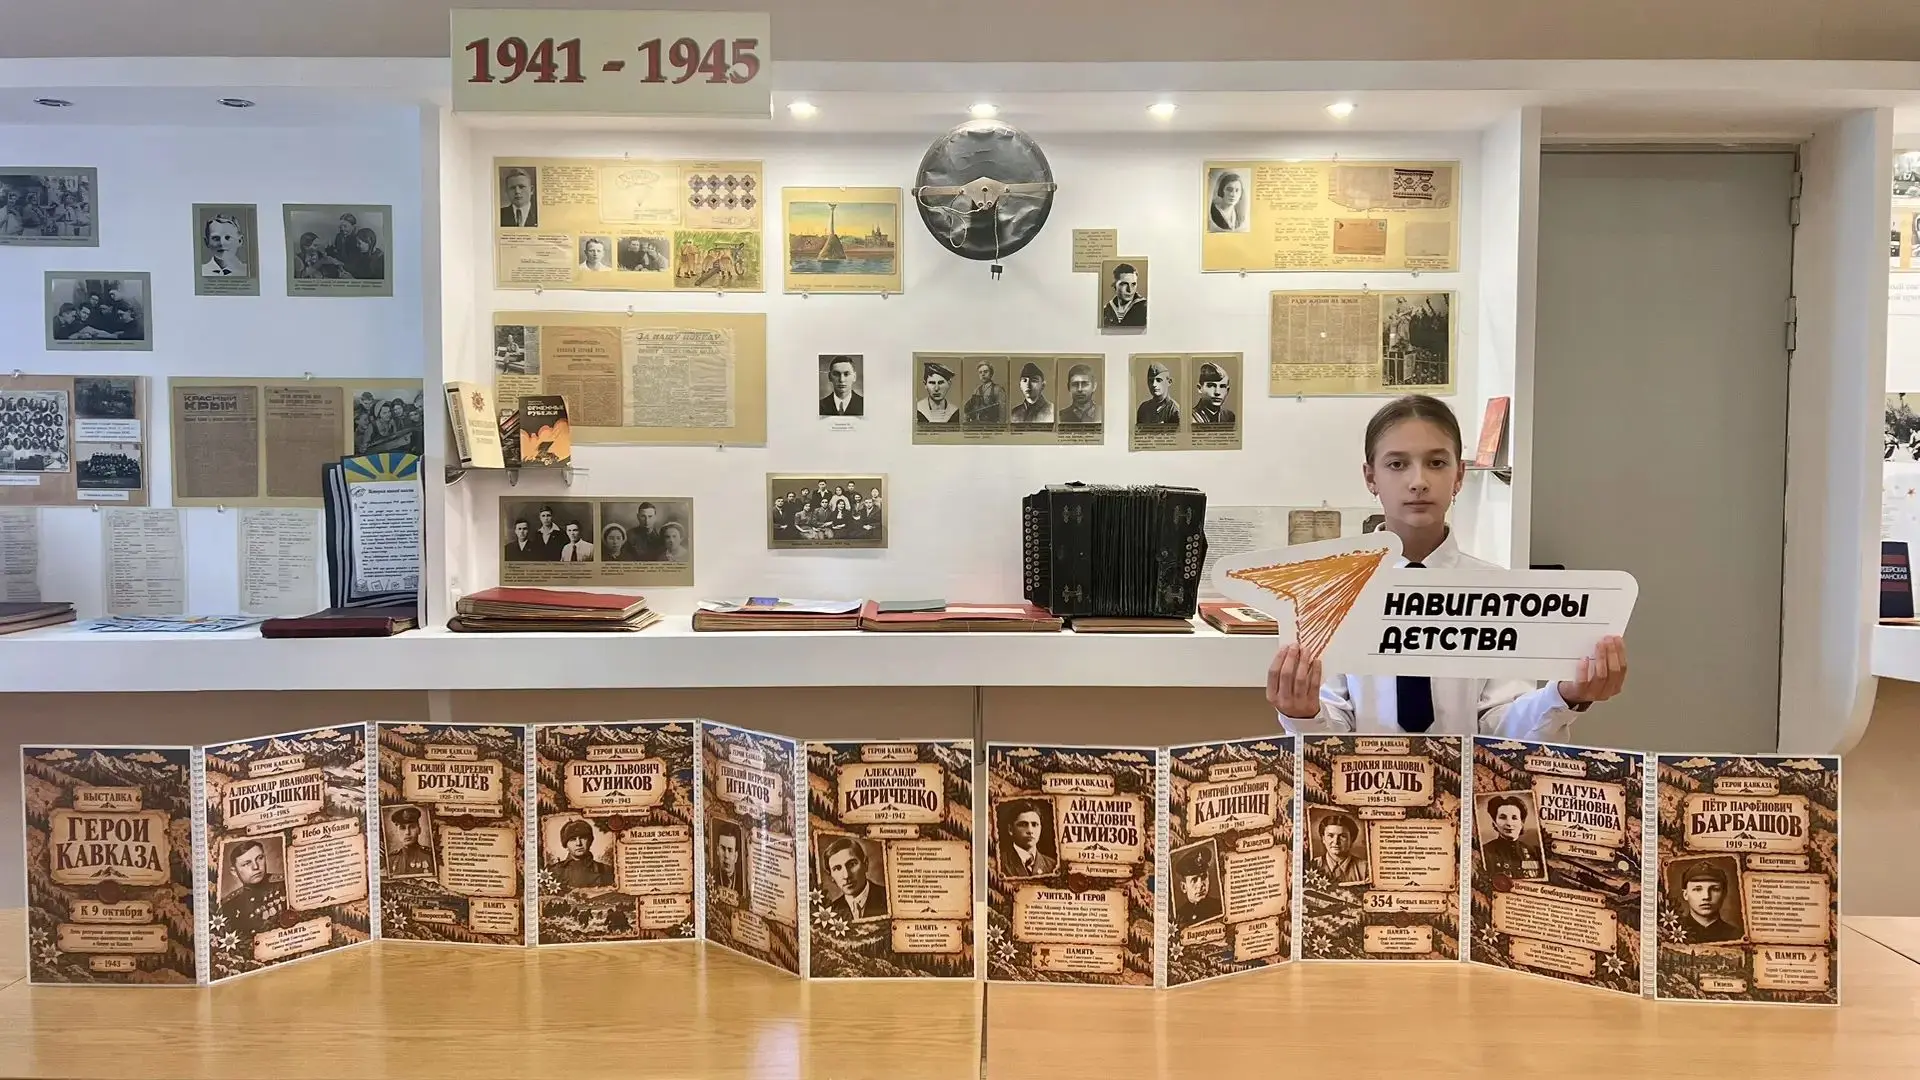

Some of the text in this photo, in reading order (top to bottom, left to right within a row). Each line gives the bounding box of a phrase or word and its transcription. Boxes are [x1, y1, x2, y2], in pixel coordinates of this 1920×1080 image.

[466, 37, 760, 84] 1941 - 1945
[184, 402, 238, 410] КРЫМ
[1384, 592, 1589, 617] НАВИГАТОРЫ
[1379, 627, 1517, 653] ДЕТСТВА
[254, 759, 301, 771] ГЕРОИ КАВКАЗА
[411, 763, 494, 774] ВАСИЛИЙ АНДРЕЕВИЧ
[573, 764, 659, 777] ЦЕЗАРЬ ЛЬВОВИЧ
[1341, 760, 1425, 773] ЕВДОКИЯ ИВАНОВНА
[1531, 759, 1580, 770] ГЕРОИ КАВКАЗА
[864, 768, 917, 778] АЛЕКСАНДР
[229, 774, 320, 797] АЛЕКСАНДР ИВАНОВИЧ
[418, 773, 489, 791] БОТЫЛЁВ
[582, 776, 652, 793] КУНИКОВ
[748, 772, 775, 789] ПЕТРОВИЧ
[855, 778, 926, 788] ПОЛИКАРПОВИЧ
[1050, 778, 1109, 789] ГЕРОИ КАВКАЗА
[1345, 772, 1422, 793] НОСАЛЬ
[84, 793, 132, 802] ВЫСТАВКА
[726, 778, 769, 803] ИГНАТОВ
[1197, 782, 1269, 800] ДМИТРИЙ СЕМЁНОВИЧ
[1552, 783, 1606, 801] МАГУБА
[229, 784, 320, 818] ПОКРЫШКИН
[845, 788, 938, 813] КИРИЧЕНКО
[1070, 797, 1132, 813] АЙДАМИР
[1540, 794, 1618, 816] ГУСЕЙНОВНА
[1702, 798, 1792, 813] ПЁТР ПАРФЁНОВИЧ
[1195, 794, 1270, 826] КАЛИНИН
[1063, 813, 1136, 826] АХМЕДОВИЧ
[1539, 807, 1621, 831] СЫРТЛАНОВА
[1691, 813, 1802, 837] БАРБАШОВ
[68, 817, 149, 842] ГЕРОИ
[302, 824, 350, 838] Небо Кубани
[879, 827, 907, 835] Командир
[1061, 826, 1138, 846] АЧМИЗОВ
[1242, 838, 1270, 848] Разведчик
[56, 842, 163, 872] КАВКАЗА
[1568, 845, 1597, 856] Лётчица
[1759, 857, 1796, 865] Пехотинец
[1037, 892, 1072, 901] УЧИТЕЛЬ
[1083, 892, 1105, 901] ГЕРОЙ
[1514, 883, 1598, 903] Ночные бомбардировщики
[1370, 895, 1392, 908] 354
[81, 906, 142, 918] К 9 октября
[278, 926, 306, 938] ПАМЯТЬ
[1249, 922, 1268, 932] ПАМЯТЬ
[1541, 943, 1564, 953] ПАМЯТЬ
[1775, 952, 1806, 961] ПАМЯТЬ
